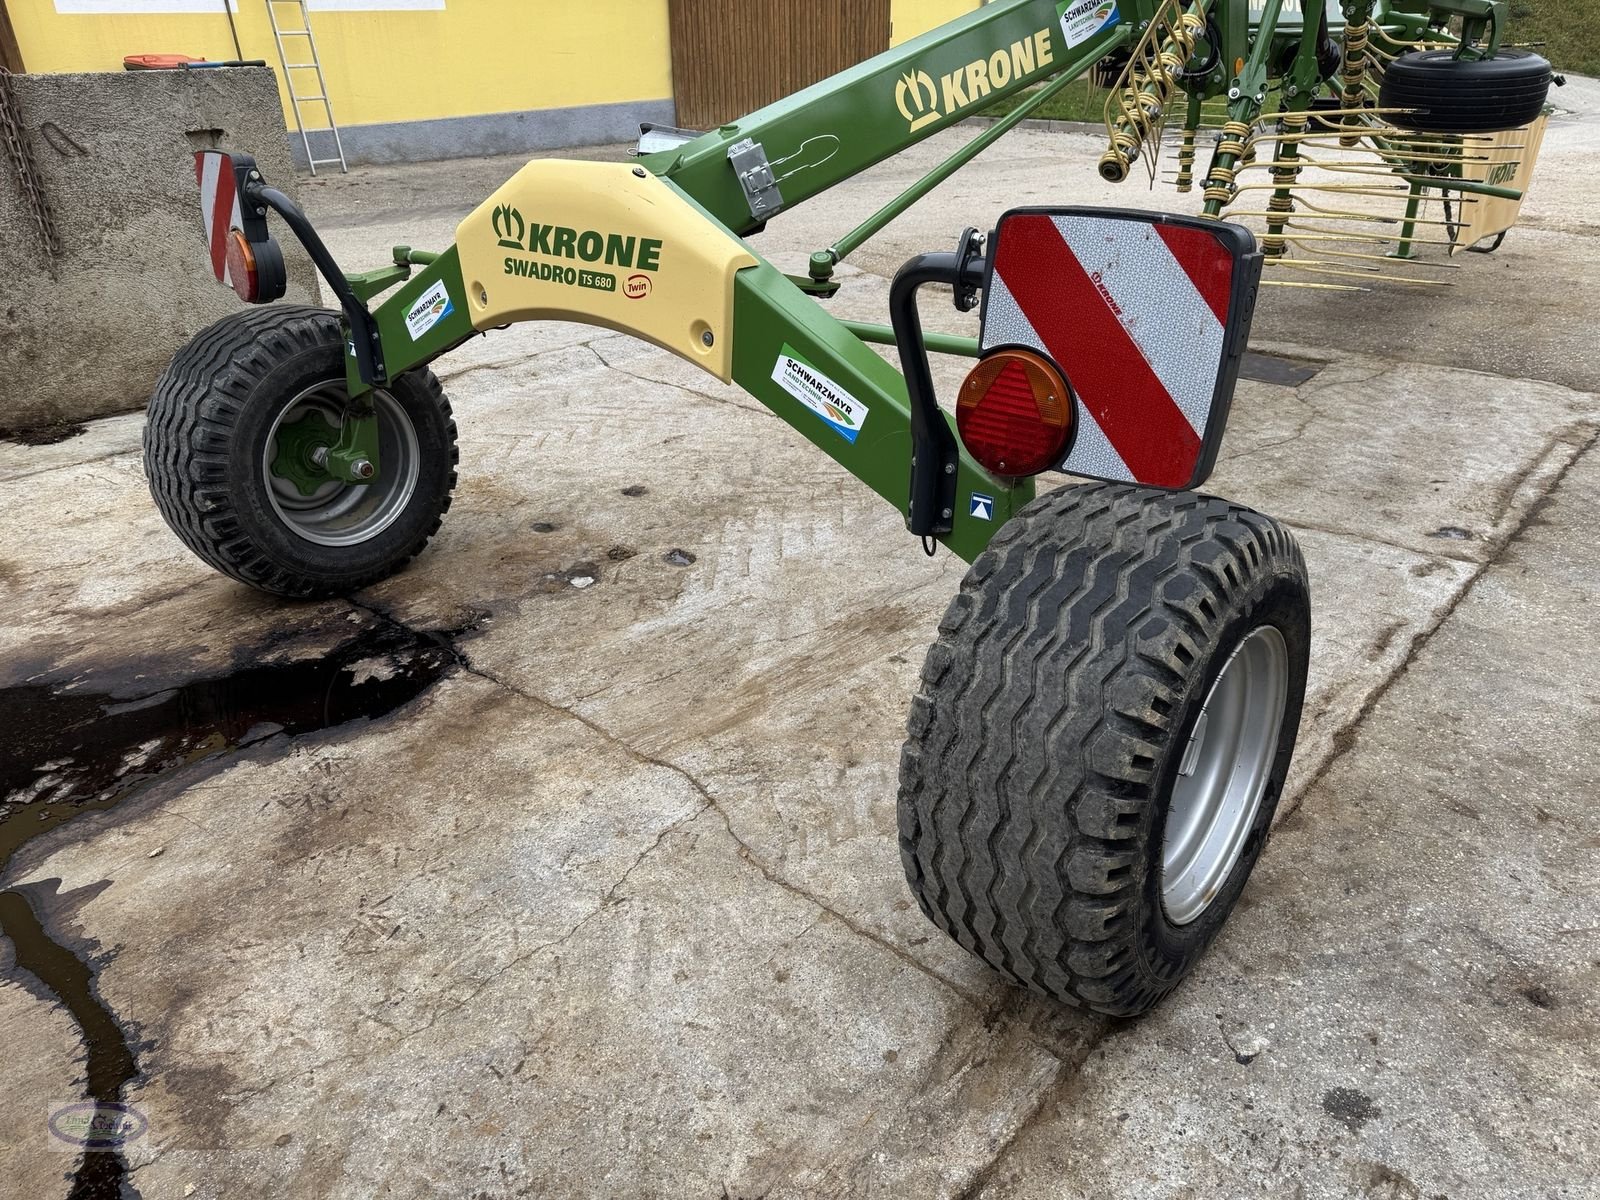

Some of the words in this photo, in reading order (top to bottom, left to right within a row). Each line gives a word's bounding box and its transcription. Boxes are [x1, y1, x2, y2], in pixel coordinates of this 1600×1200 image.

[1064, 0, 1107, 23] SCHWARZMA
[941, 27, 1054, 115] KRONE
[528, 222, 663, 272] KRONE
[504, 257, 577, 286] SWADRO
[581, 273, 593, 286] TS
[594, 275, 612, 289] 680
[627, 281, 647, 293] Twin
[408, 292, 441, 322] SCHWARZMAYR
[1097, 283, 1123, 316] KRONE
[784, 368, 823, 403] LANDTECHNIK
[786, 358, 853, 415] SCHWARZMAYR
